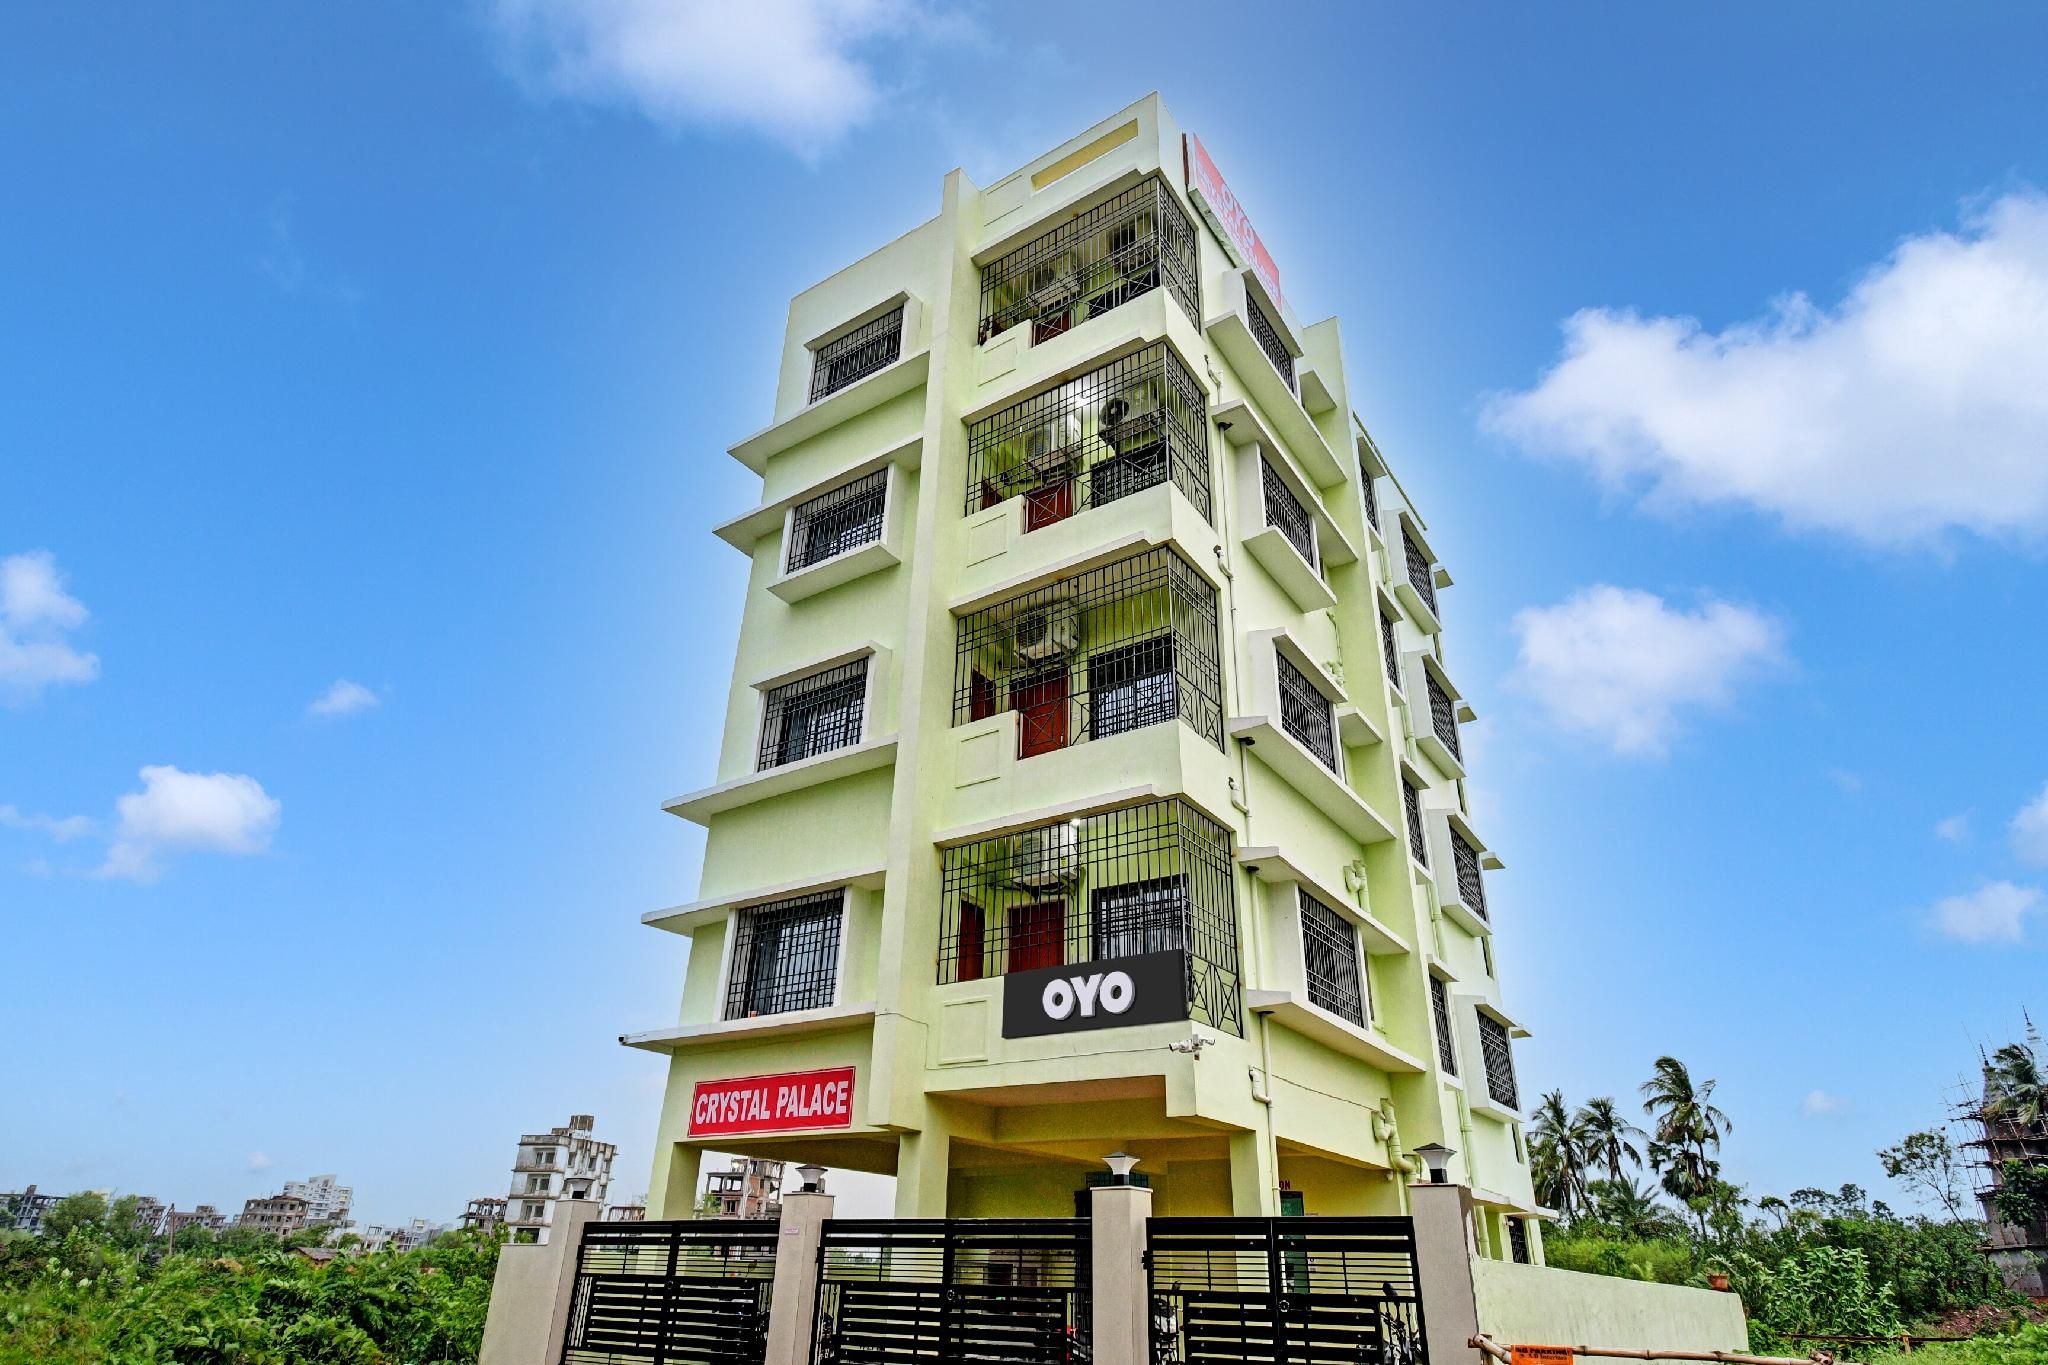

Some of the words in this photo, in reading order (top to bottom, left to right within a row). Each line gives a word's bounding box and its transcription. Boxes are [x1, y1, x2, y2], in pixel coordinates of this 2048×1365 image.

[1221, 180, 1255, 247] OYO
[1042, 971, 1136, 1021] OYO
[695, 1088, 771, 1125] CRYSTAL
[776, 1081, 849, 1118] PALACE
